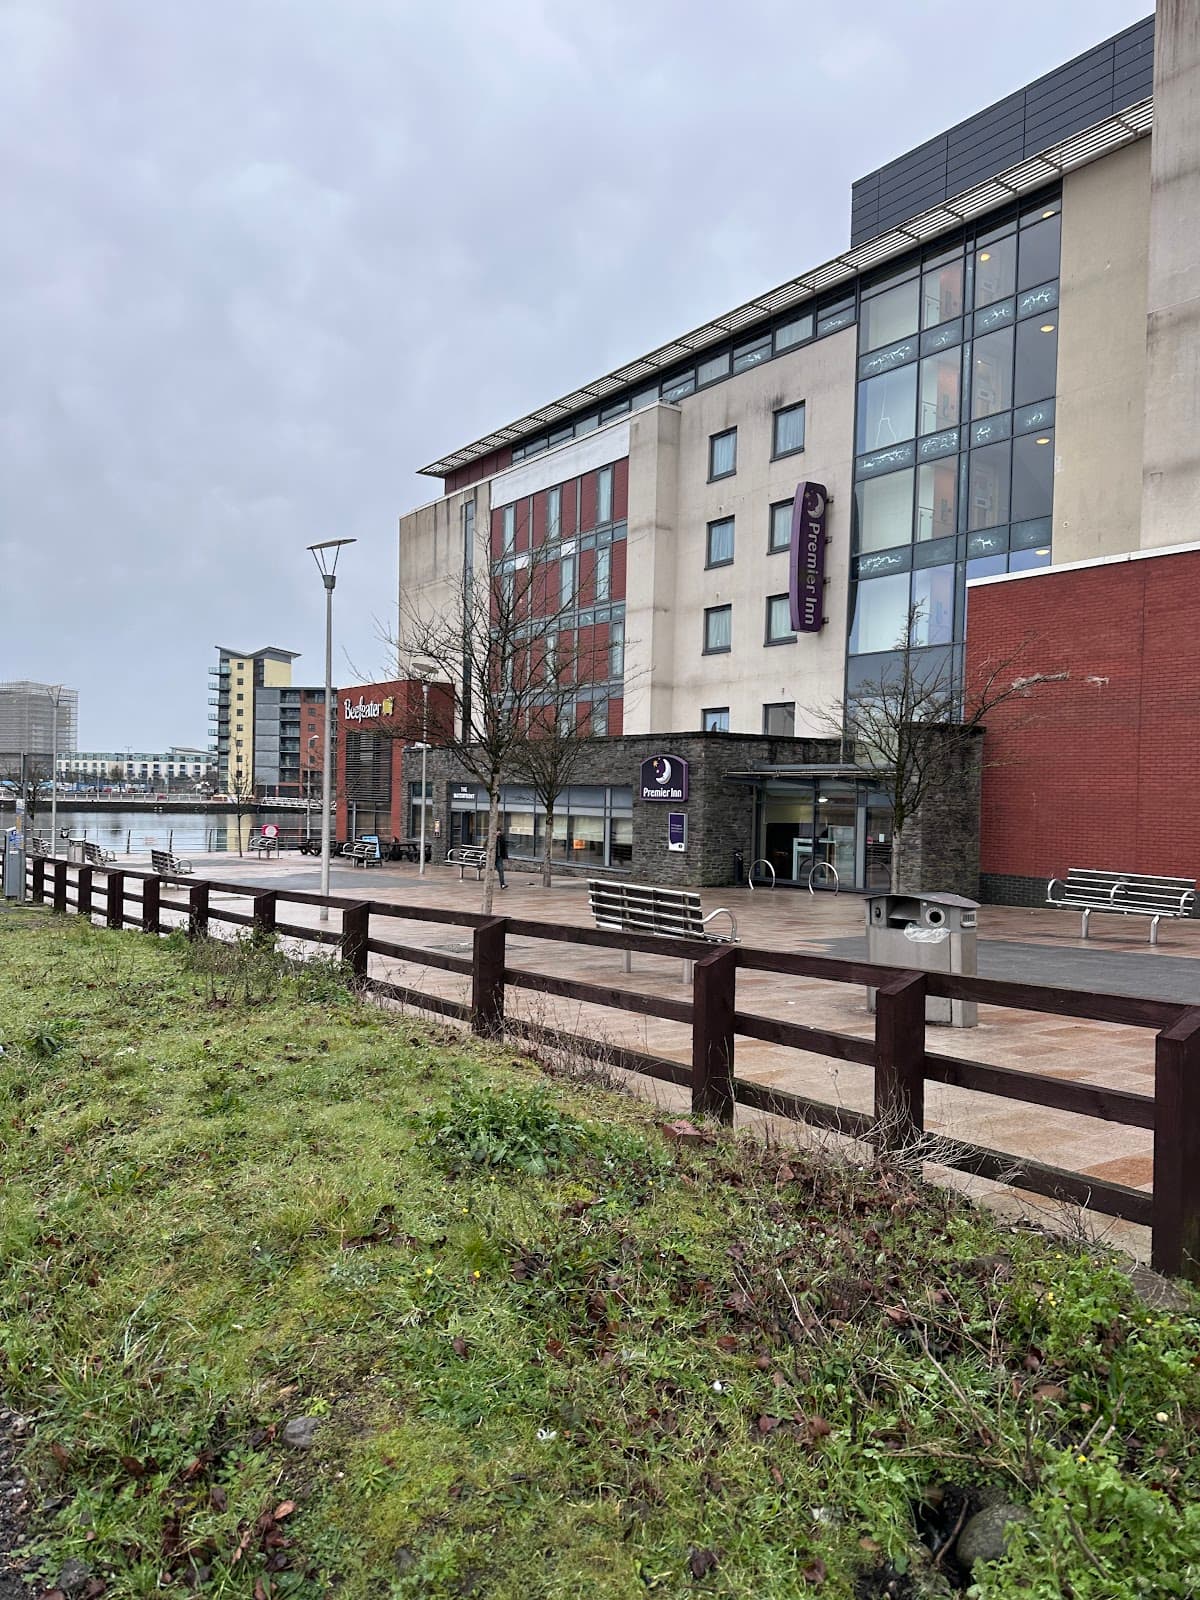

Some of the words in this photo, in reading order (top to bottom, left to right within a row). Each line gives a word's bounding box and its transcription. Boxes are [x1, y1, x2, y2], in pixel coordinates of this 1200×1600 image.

[805, 522, 821, 594] Premier
[805, 597, 818, 624] Inn
[343, 695, 382, 723] Beefeater
[643, 787, 670, 798] Premier
[671, 787, 682, 798] Inn
